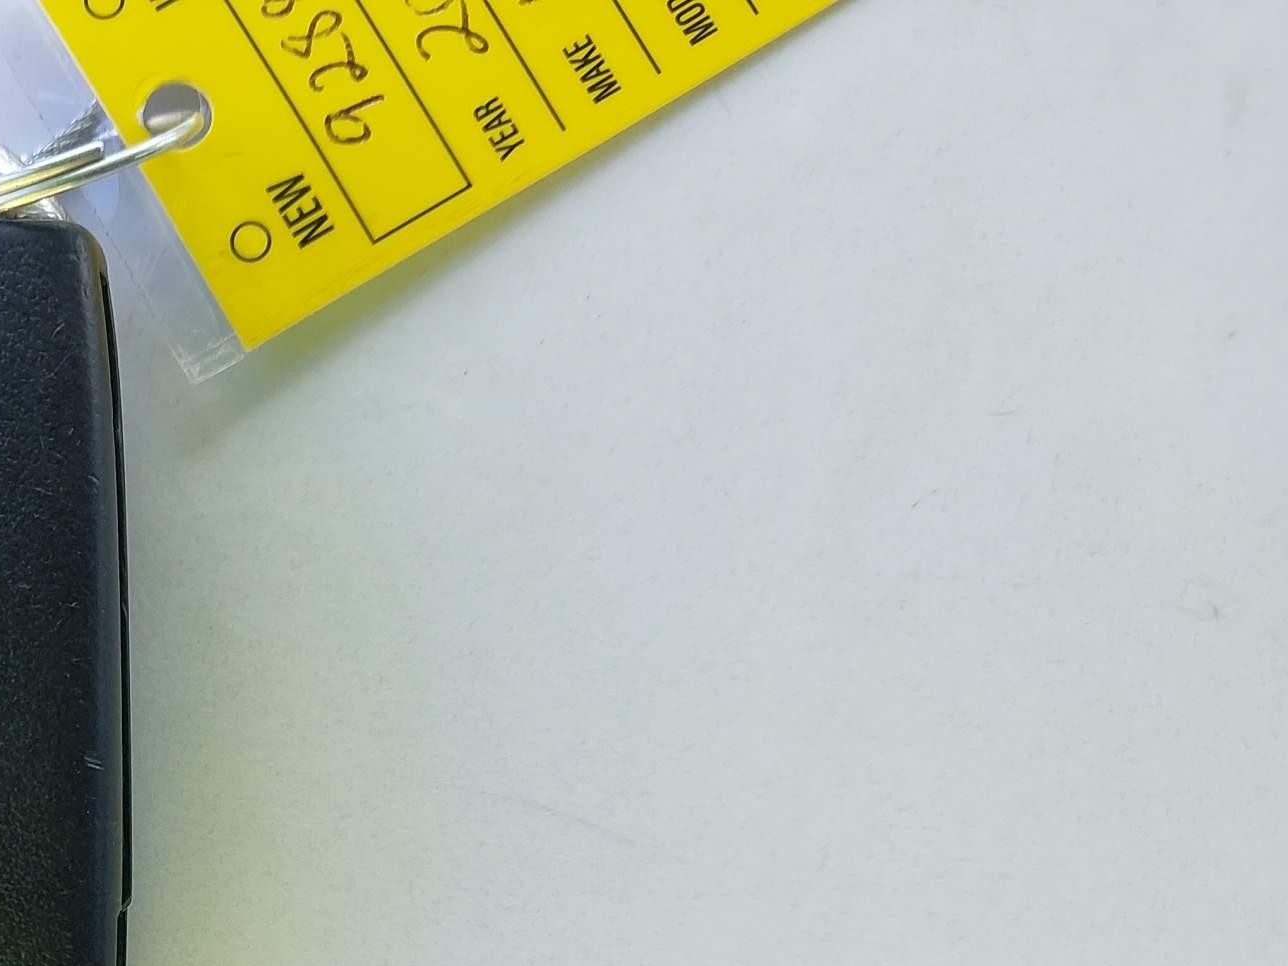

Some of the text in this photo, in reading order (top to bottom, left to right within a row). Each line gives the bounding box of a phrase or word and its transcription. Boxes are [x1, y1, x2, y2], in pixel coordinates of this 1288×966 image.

[562, 34, 621, 105] MAKE
[473, 96, 525, 162] YEAR
[265, 171, 335, 249] NEW
